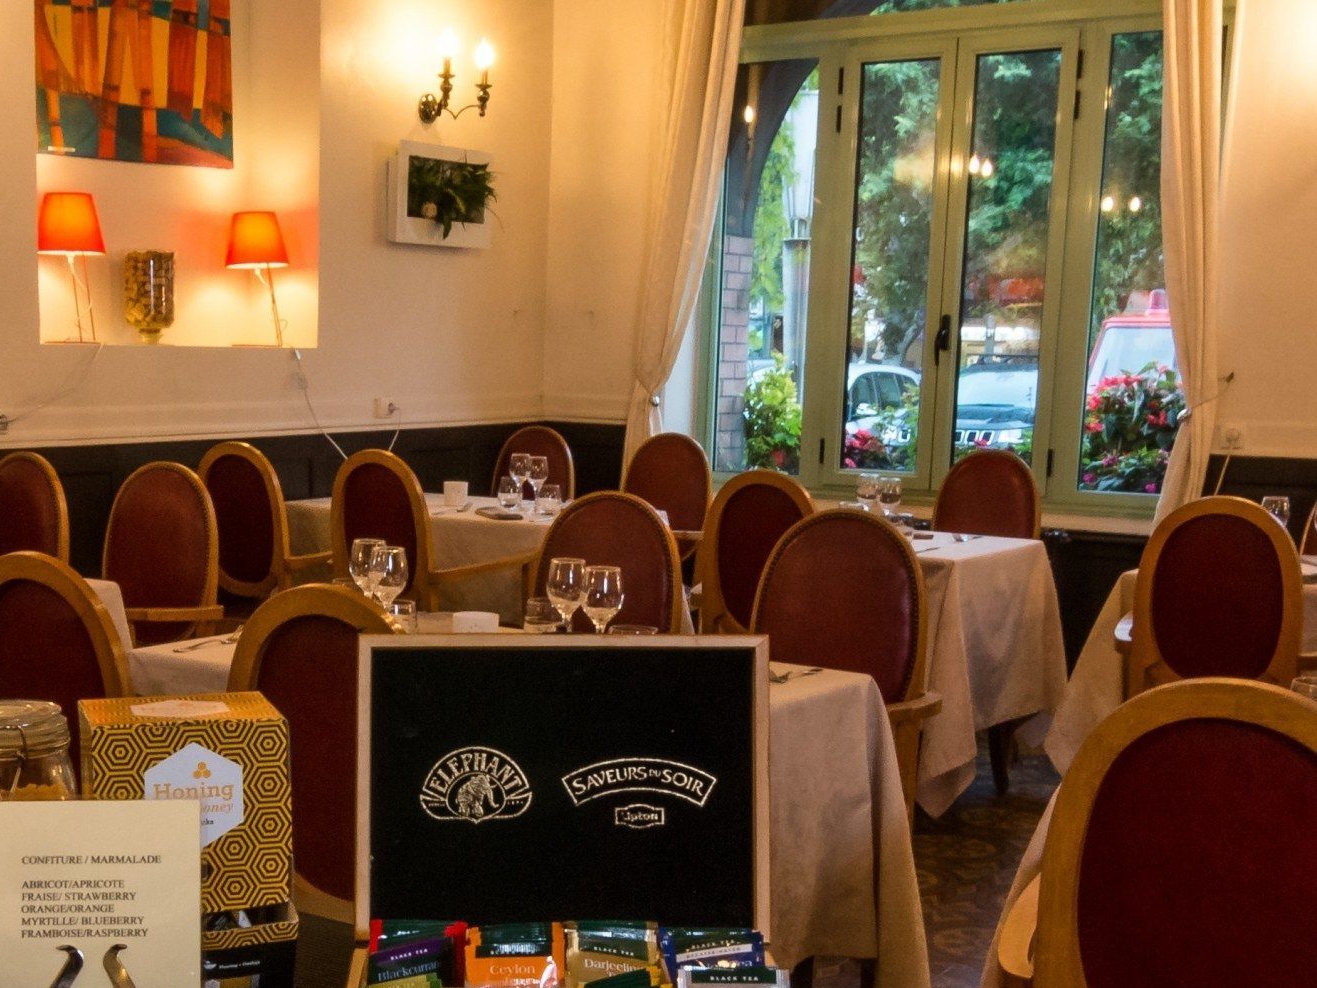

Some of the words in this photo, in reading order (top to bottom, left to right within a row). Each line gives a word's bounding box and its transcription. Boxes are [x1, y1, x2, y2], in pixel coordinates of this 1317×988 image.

[429, 752, 523, 793] ELEPHANT
[572, 766, 647, 795] SAVEURS
[661, 769, 703, 796] SOIR
[153, 782, 234, 801] Honing
[21, 855, 83, 865] CONFITURE
[90, 854, 162, 864] MARMALADE
[21, 880, 125, 889] ABRICOT/APRICOTE
[64, 892, 136, 901] STRAWBERRY
[21, 904, 115, 914] ORANGE/ORANGE
[81, 916, 144, 926] BLUEBERRY
[21, 928, 149, 938] FRAMBOISE/RASPBERRY
[489, 965, 536, 976] Ceylon
